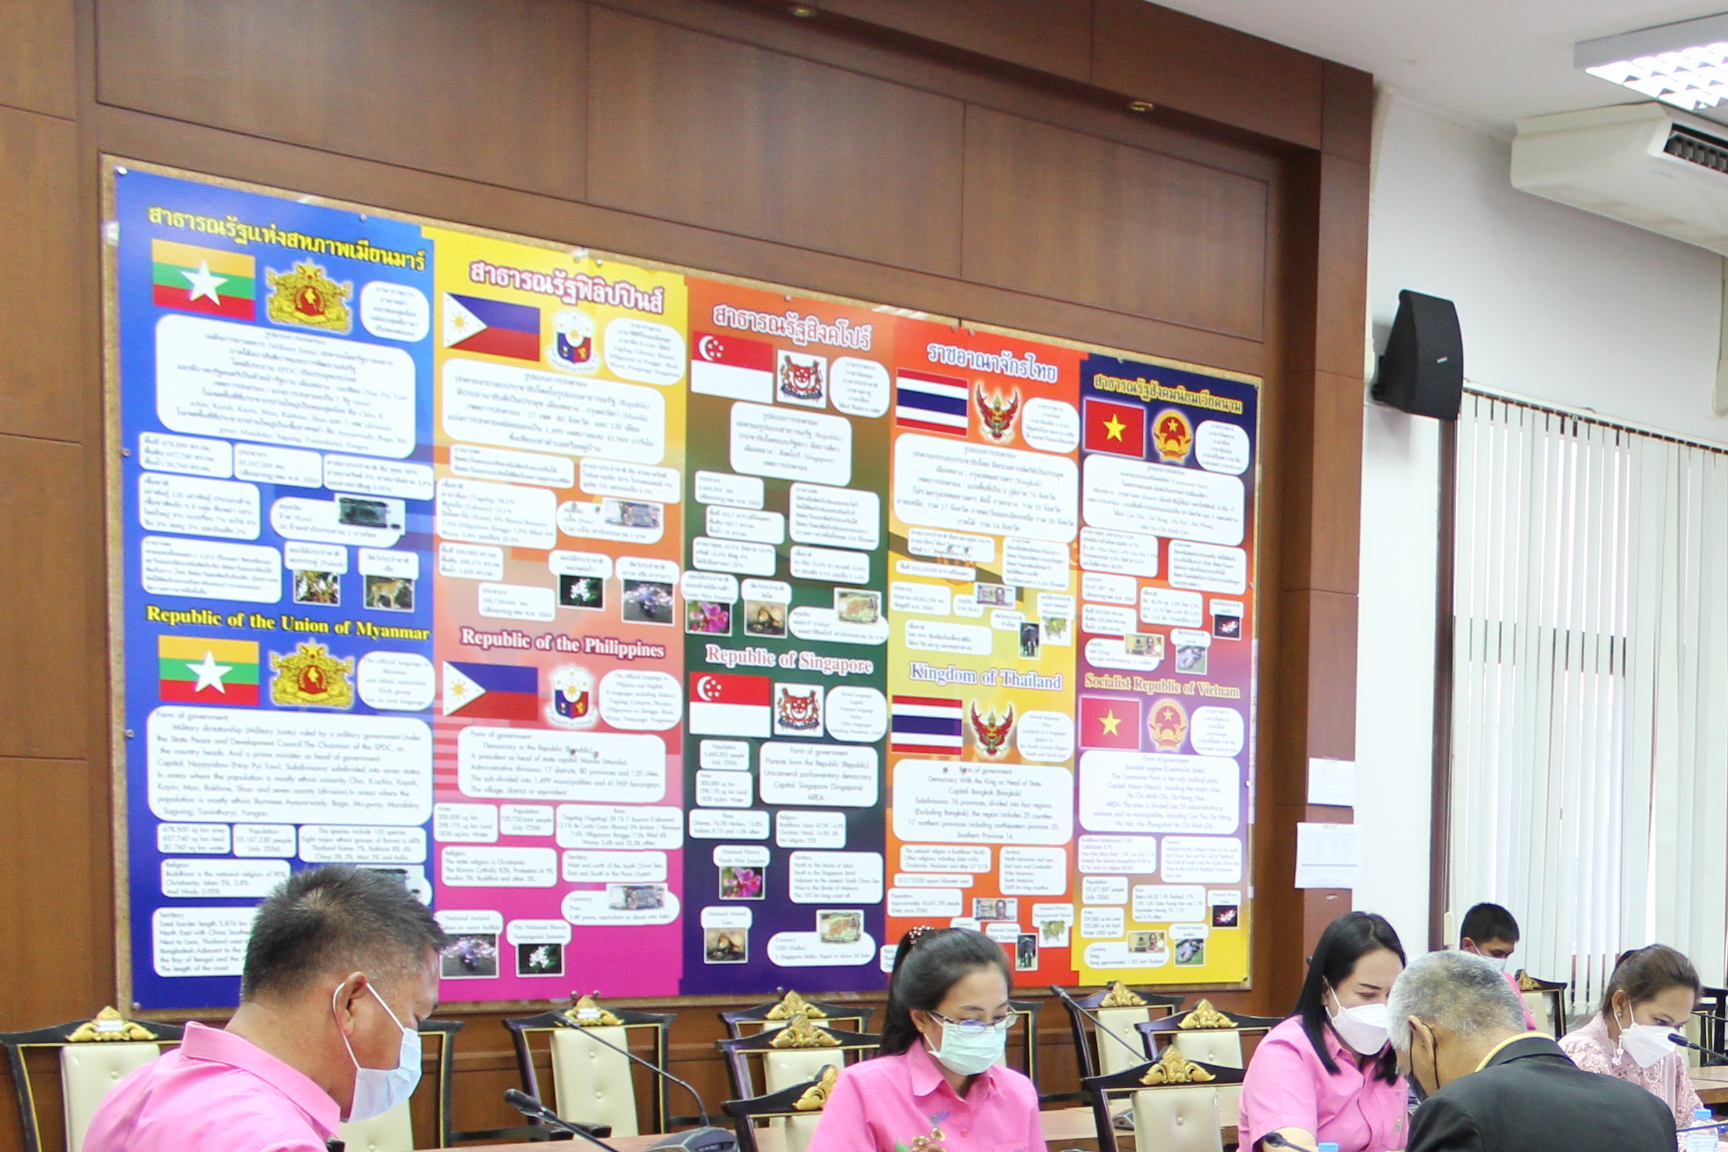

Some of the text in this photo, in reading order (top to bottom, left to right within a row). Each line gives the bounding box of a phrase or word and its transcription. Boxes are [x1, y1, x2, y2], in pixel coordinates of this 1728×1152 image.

[148, 206, 427, 271] สาธารณรัฐแห่งสหภาพเมียนมาร์
[469, 260, 665, 315] สาธารณรัฐฟิลิปปินส์
[713, 305, 872, 351] สาธารณรัฐสิงคโปร์
[927, 343, 1058, 383] ราชอาณาจักรไทย
[1093, 373, 1243, 415] สาธารณรัฐสังคมนิยมเวียดนาม
[146, 605, 431, 641] Republic of the Union of Myanmar
[461, 627, 665, 660] Republic of the Philippines
[706, 645, 874, 676] Republic of Singapore
[910, 662, 1063, 691] Kingdom of Thailand
[1085, 673, 1241, 698] Socialist Republic of Vietnam
